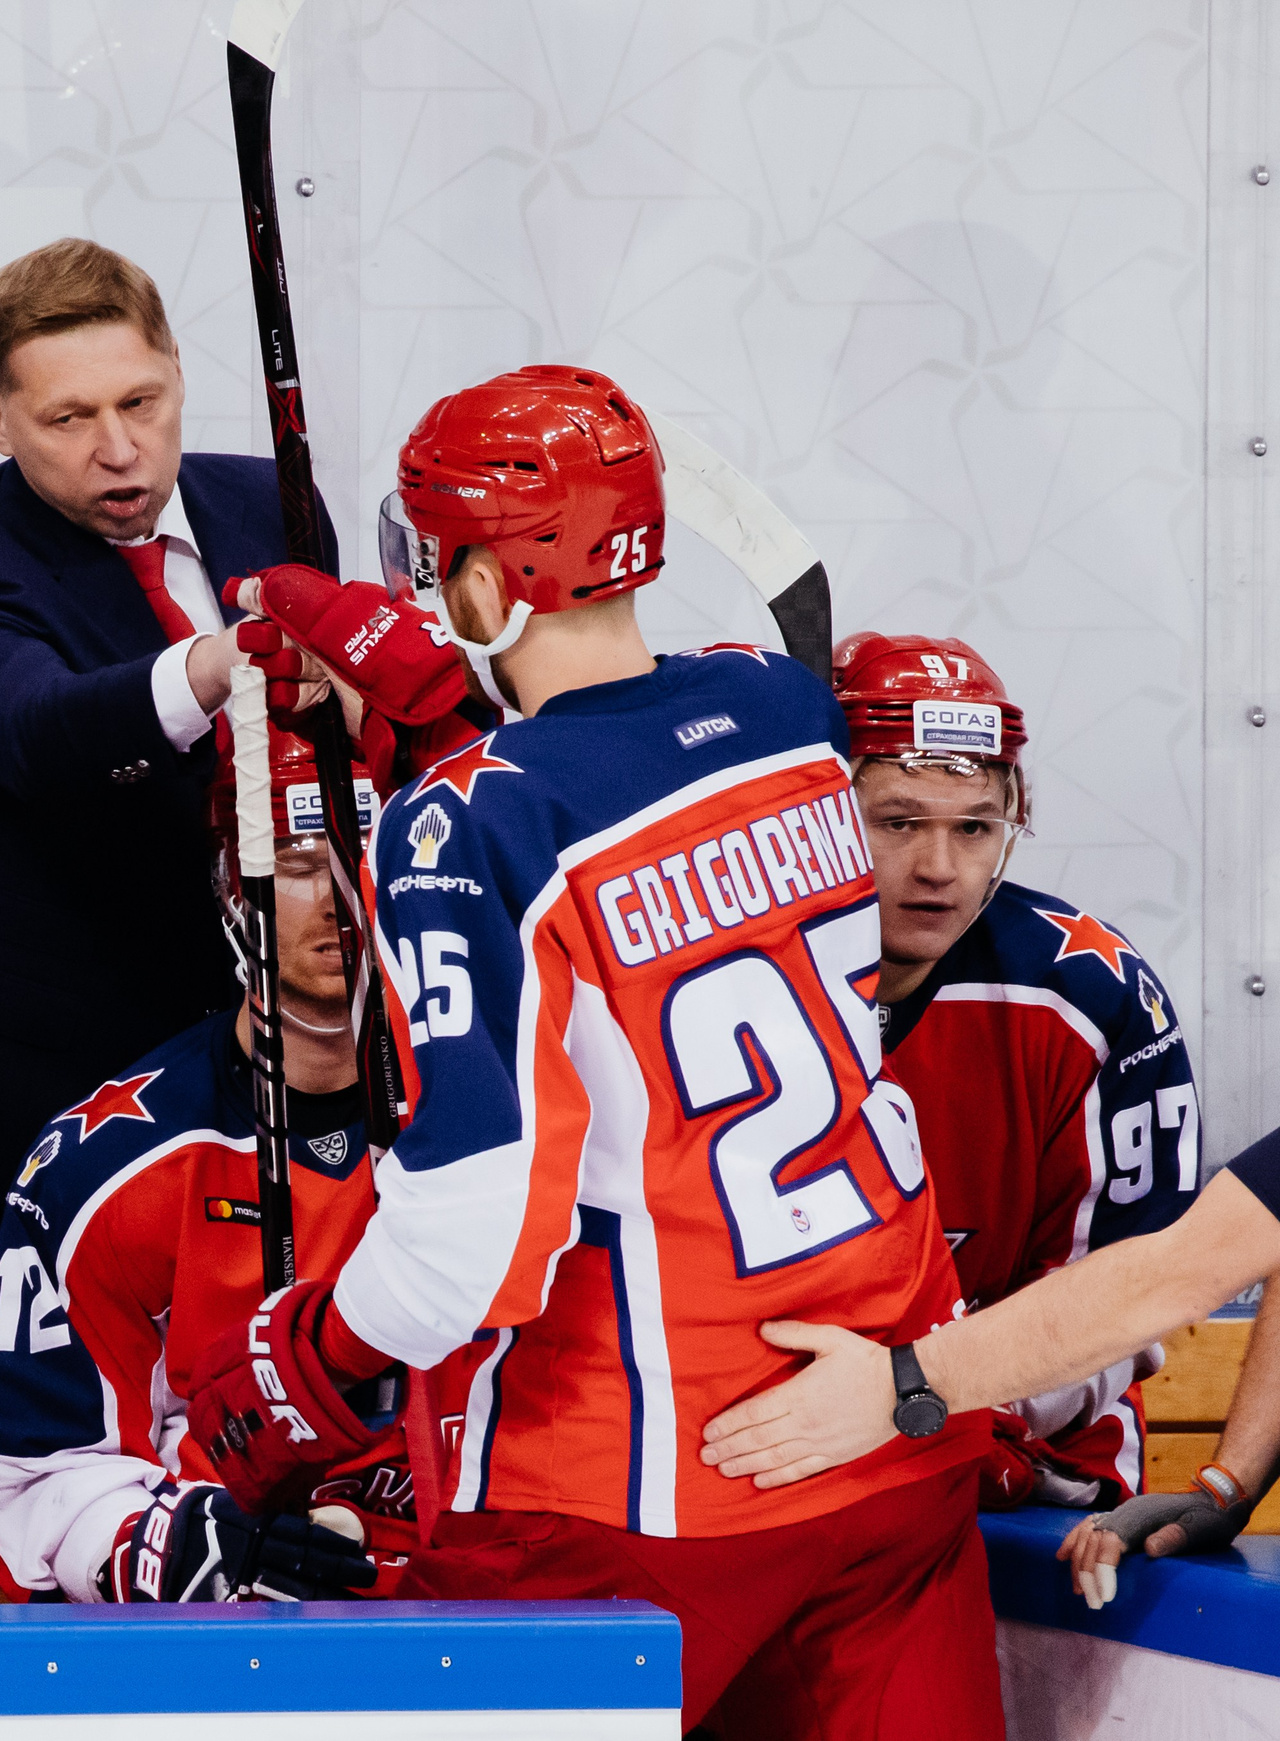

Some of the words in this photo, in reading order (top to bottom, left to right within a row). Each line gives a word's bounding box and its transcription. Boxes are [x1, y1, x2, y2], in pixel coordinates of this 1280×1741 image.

[272, 329, 283, 370] LITE
[610, 526, 648, 578] 25
[344, 624, 368, 653] PRO
[349, 610, 400, 666] NEXUS
[920, 654, 968, 680] 97
[677, 716, 736, 745] LUTCH
[922, 710, 995, 728] СОГАЗ
[381, 1036, 398, 1118] GRIGORENKO
[1108, 1082, 1198, 1204] 97
[282, 1236, 296, 1286] HANSEN
